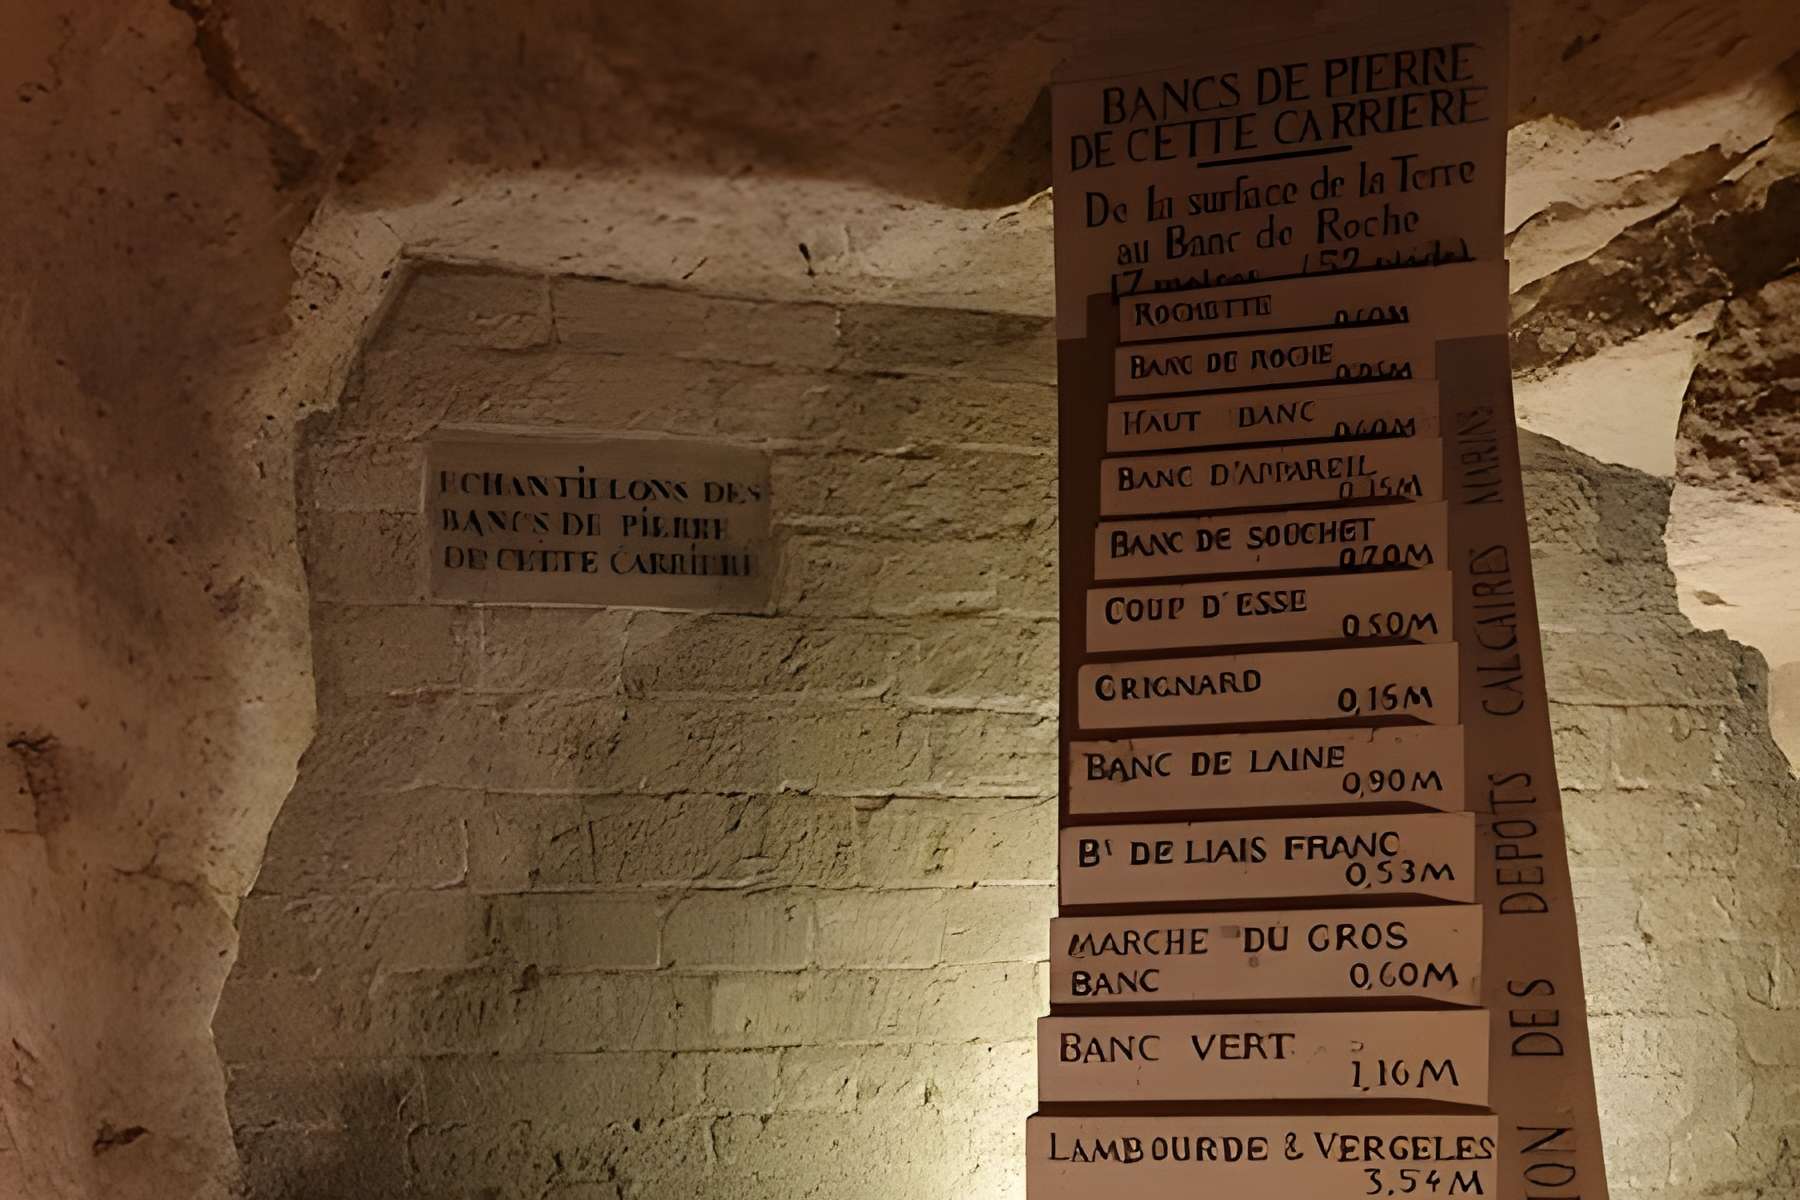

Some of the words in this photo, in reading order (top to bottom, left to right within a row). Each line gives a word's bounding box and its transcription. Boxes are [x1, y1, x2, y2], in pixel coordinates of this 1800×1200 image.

[1103, 73, 1241, 125] BANCS
[1258, 63, 1309, 106] DE
[1324, 42, 1483, 98] PIERRE
[1071, 130, 1115, 172] DE
[1127, 113, 1257, 161] CETTE
[1274, 86, 1488, 145] CARRIERE
[1086, 191, 1127, 228] De
[1148, 184, 1173, 221] la
[1188, 175, 1297, 217] surface
[1311, 165, 1344, 200] de
[1360, 161, 1384, 197] la
[1391, 153, 1476, 193] Terre
[1118, 239, 1149, 265] au
[1166, 225, 1240, 260] Banc
[1257, 215, 1292, 250] de
[1318, 204, 1420, 244] Roche
[1131, 354, 1192, 379] BANC
[1207, 350, 1237, 373] DE
[1251, 343, 1333, 370] ROCHE
[1123, 410, 1201, 436] HAUT
[1238, 401, 1317, 429] BANC
[703, 480, 761, 504] DES
[1117, 465, 1193, 492] BANC
[441, 508, 550, 537] BANCS
[561, 511, 601, 536] DE
[1110, 529, 1183, 558] BANC
[1196, 527, 1231, 553] DE
[1246, 517, 1376, 550] SOUCHET
[444, 545, 487, 571] DE
[1105, 596, 1184, 625] COUP
[1203, 589, 1308, 619] D'ESSE
[1470, 543, 1526, 718] CALCAIRES
[1083, 752, 1173, 782] BANC
[1191, 750, 1232, 776] DE
[1250, 745, 1345, 772] LAINE
[1131, 839, 1174, 866] DE
[1184, 836, 1267, 865] LIAIS
[1284, 831, 1400, 861] FRANC
[1488, 771, 1550, 915] DEPOTS
[1068, 927, 1209, 959] MARCHE
[1243, 925, 1289, 953] DU
[1308, 921, 1408, 951] GROS
[1071, 968, 1160, 997] BANC
[1506, 977, 1564, 1056] DES
[1059, 1032, 1161, 1063] BANC
[1192, 1032, 1296, 1061] VERT
[1048, 1131, 1268, 1164] LAMBOURDE
[1285, 1133, 1304, 1160] &
[1313, 1131, 1496, 1163] VERGELES
